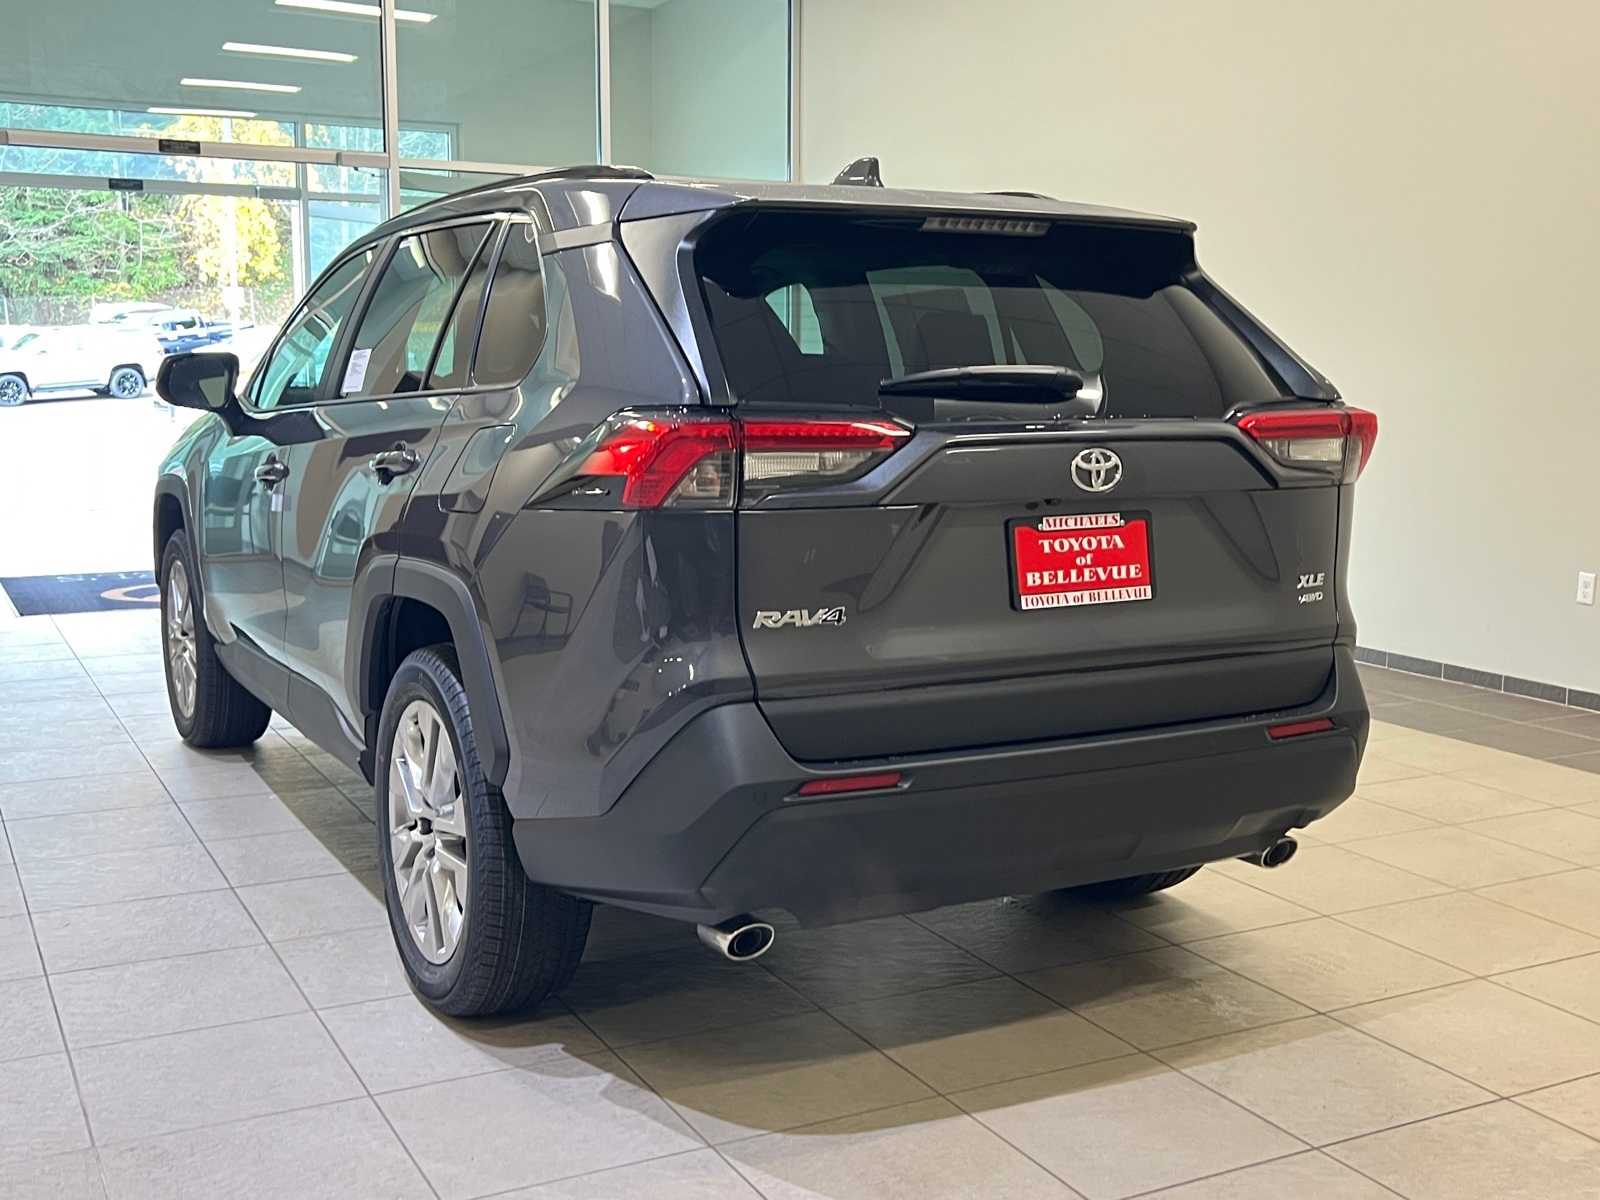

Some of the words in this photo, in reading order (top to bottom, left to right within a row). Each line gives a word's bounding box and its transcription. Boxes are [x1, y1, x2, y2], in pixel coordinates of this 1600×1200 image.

[1039, 535, 1125, 553] TOYOTA
[1075, 553, 1093, 566] of
[1026, 564, 1142, 587] BELLEVUE
[1296, 572, 1325, 589] XLE
[1024, 595, 1070, 608] TOYOTA
[1073, 594, 1084, 604] of
[1089, 587, 1150, 602] BELLEVUE
[752, 606, 847, 629] RAV4
